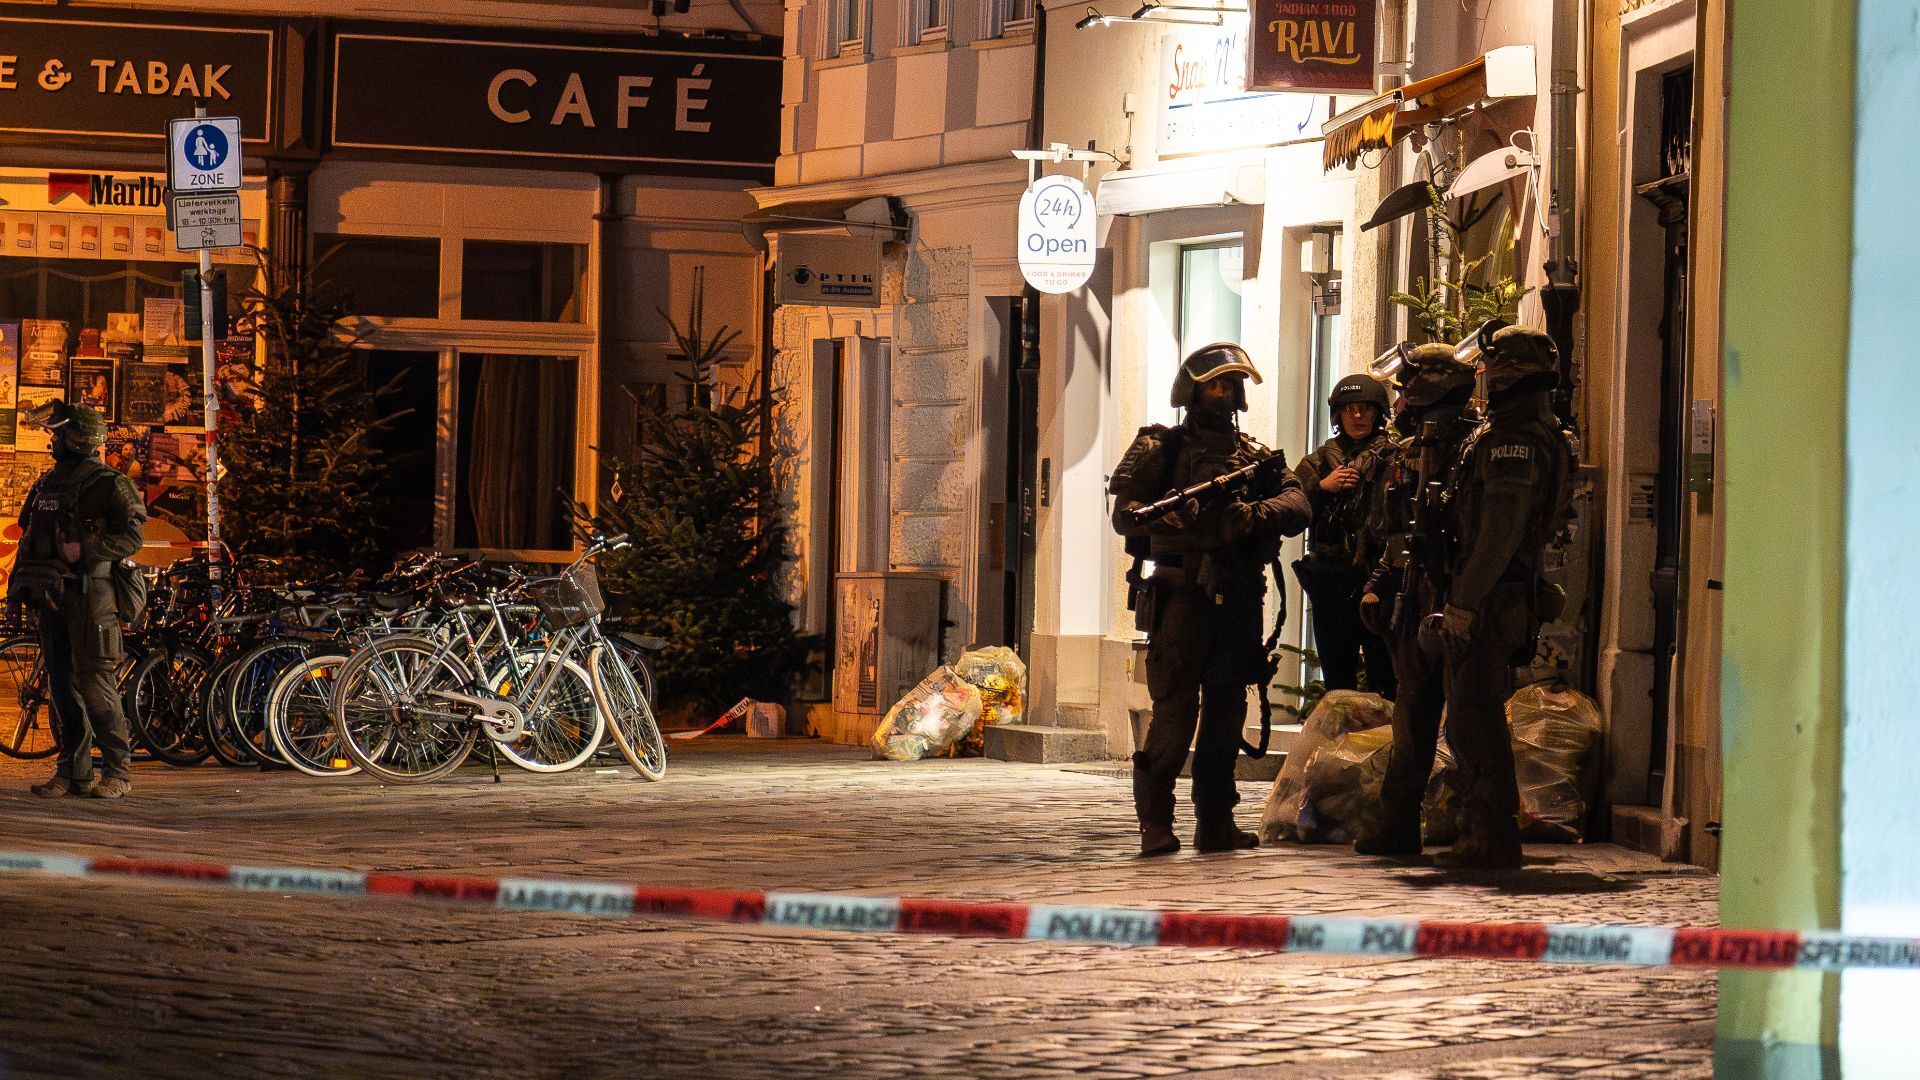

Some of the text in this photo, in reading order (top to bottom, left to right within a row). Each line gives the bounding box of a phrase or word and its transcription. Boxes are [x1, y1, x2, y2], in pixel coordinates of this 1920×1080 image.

[1268, 19, 1361, 65] RAVI
[38, 58, 72, 91] &
[90, 58, 233, 100] TABAK
[487, 63, 713, 133] CAFÉ
[190, 172, 225, 186] ZONE
[1039, 197, 1077, 217] 24h
[1027, 232, 1087, 257] Open
[1490, 444, 1529, 461] POLIZEI
